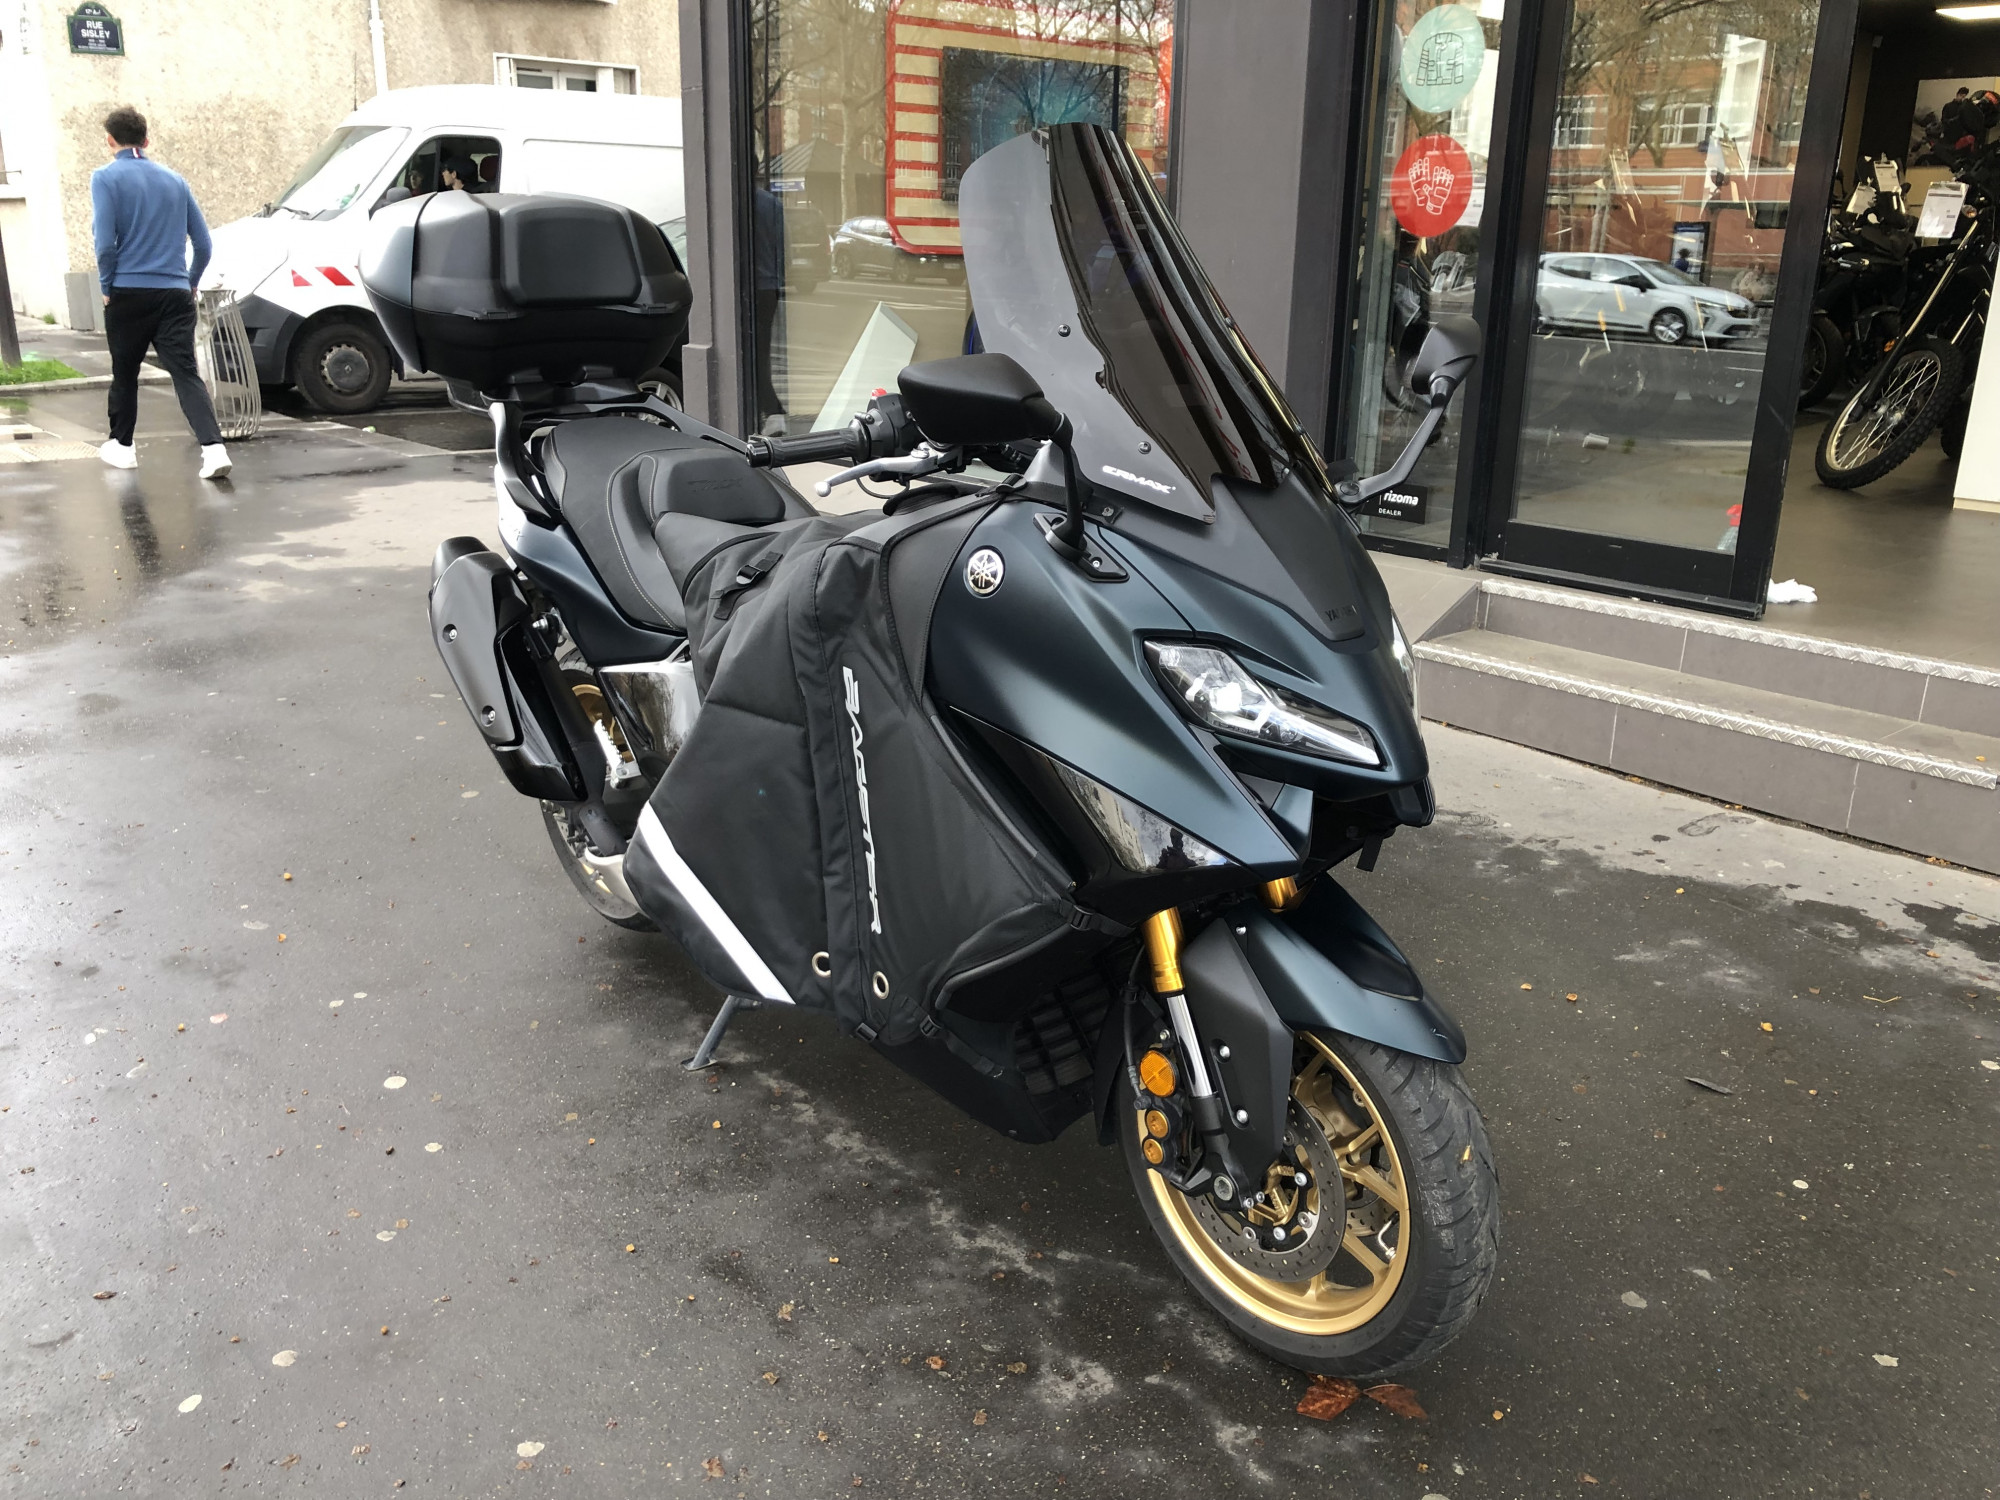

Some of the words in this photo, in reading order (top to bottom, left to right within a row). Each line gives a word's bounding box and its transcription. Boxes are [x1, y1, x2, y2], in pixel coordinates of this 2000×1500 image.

[86, 20, 104, 30] RUE
[80, 29, 111, 39] SISLEY
[1102, 465, 1173, 495] ERMAX
[1383, 489, 1420, 506] rizoma
[1378, 508, 1402, 517] DEALER
[842, 665, 882, 935] BAGSTER
